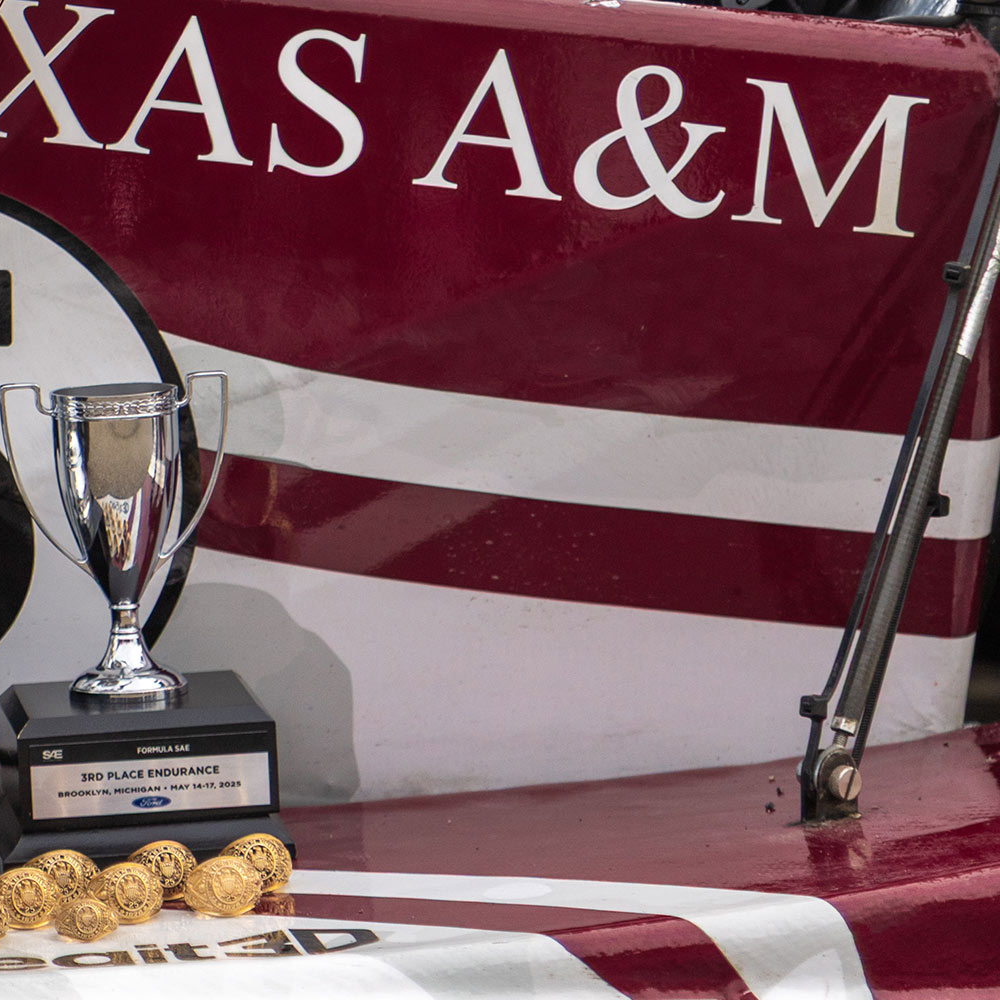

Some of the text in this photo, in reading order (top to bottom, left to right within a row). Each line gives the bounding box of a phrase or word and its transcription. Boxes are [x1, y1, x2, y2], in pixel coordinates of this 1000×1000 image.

[412, 48, 929, 238] A&M
[42, 749, 63, 760] SAE
[136, 744, 190, 754] FORMULA SAE
[80, 765, 220, 782] 3RD PLACE ENDURANCE
[58, 788, 112, 798] BROOKLYN,
[114, 785, 161, 794] MICHIGAN
[193, 782, 217, 790] 14-17,
[137, 796, 165, 807] Ford
